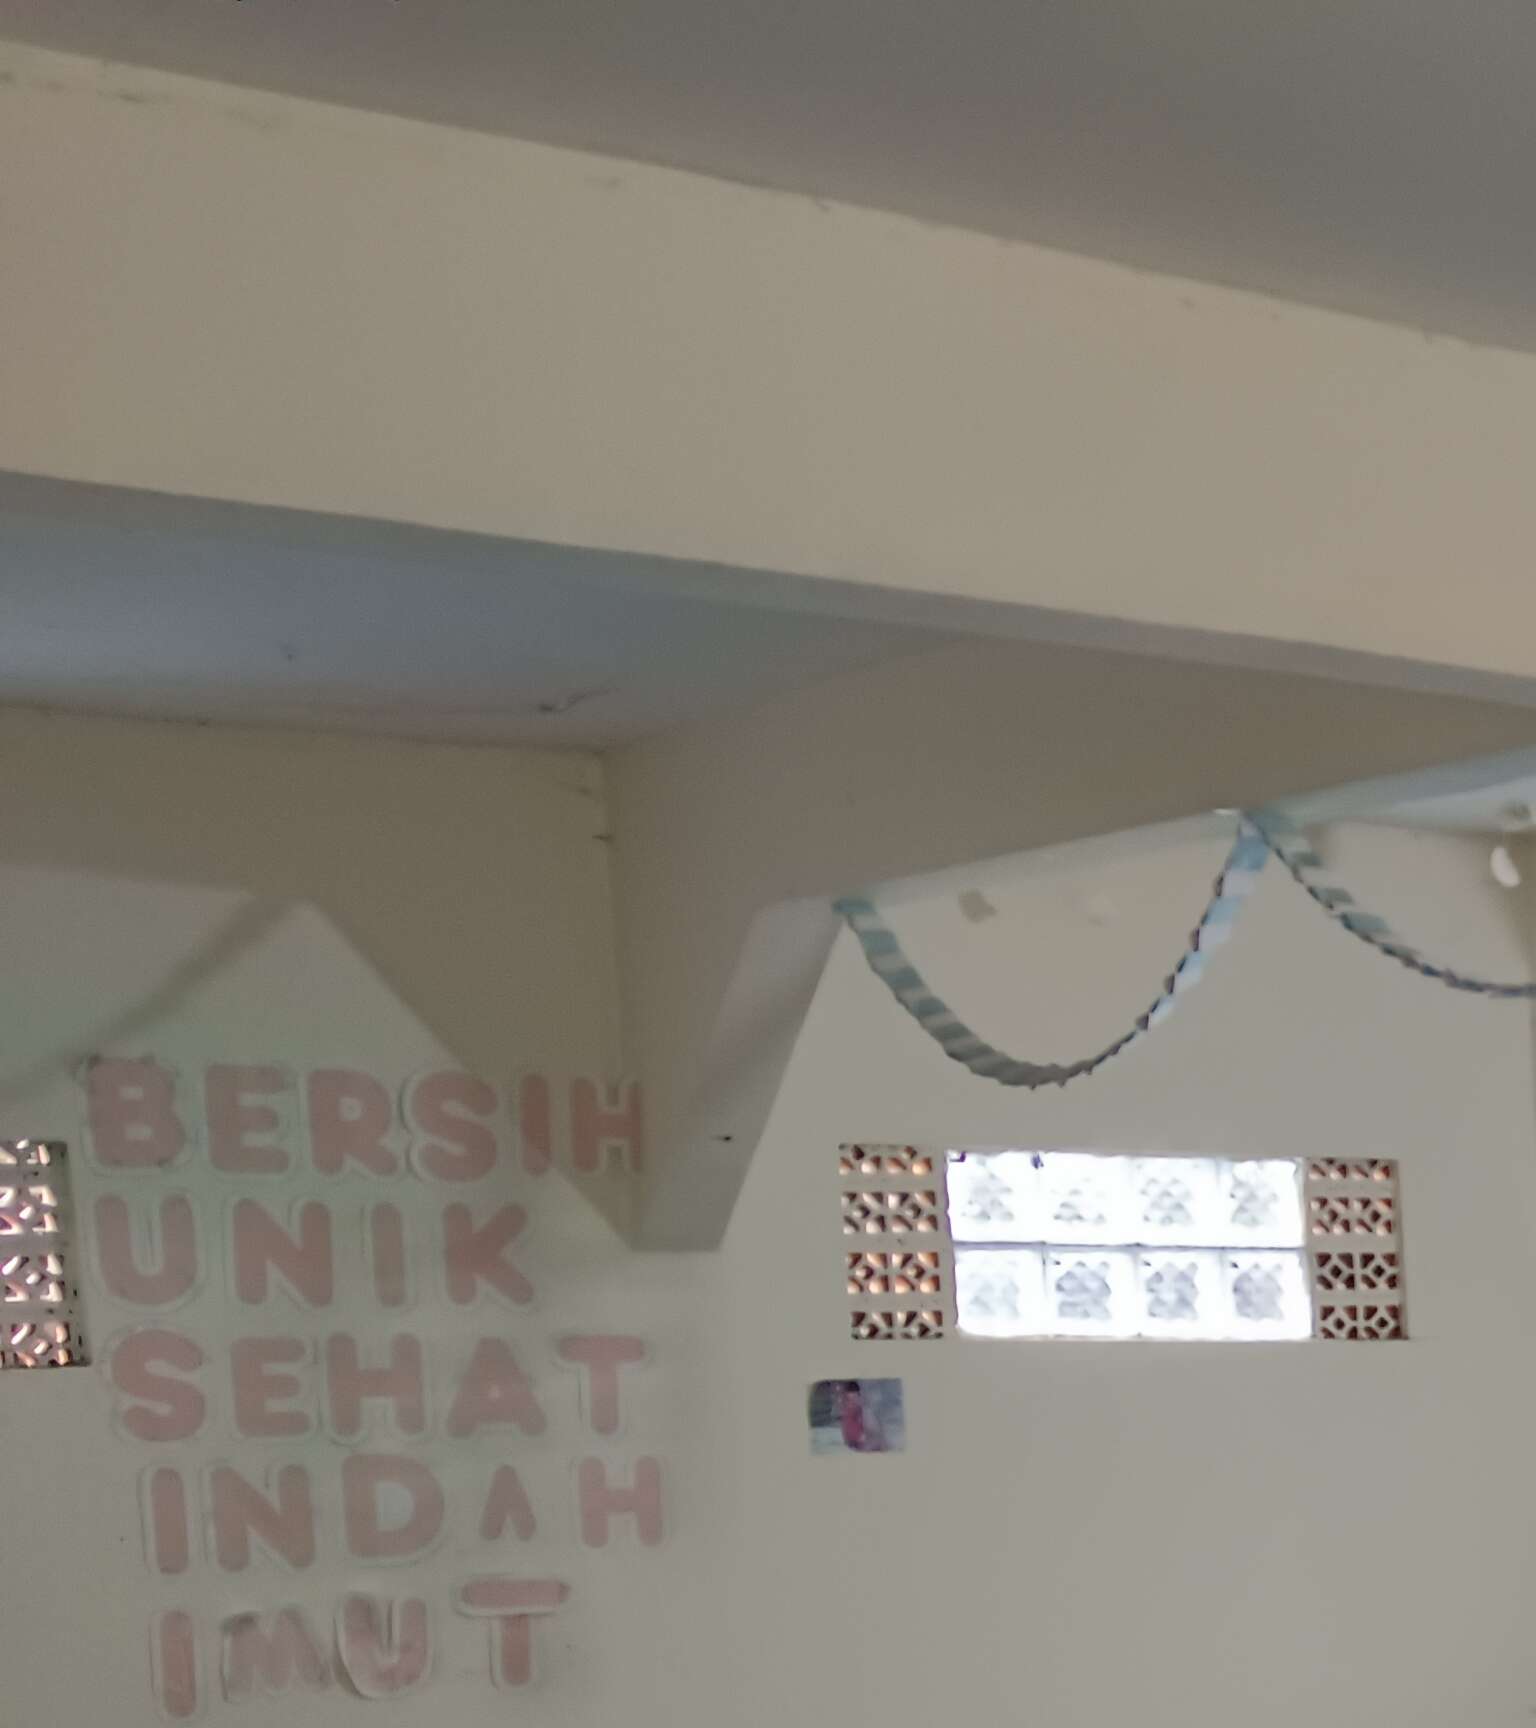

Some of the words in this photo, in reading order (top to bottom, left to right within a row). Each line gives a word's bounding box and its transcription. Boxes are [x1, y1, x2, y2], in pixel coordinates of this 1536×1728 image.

[85, 1055, 644, 1183] BERSIH
[94, 1194, 537, 1308] UNIK
[110, 1328, 646, 1443] SEHAT
[149, 1453, 666, 1576] INDAH
[154, 1578, 572, 1719] IMUT
